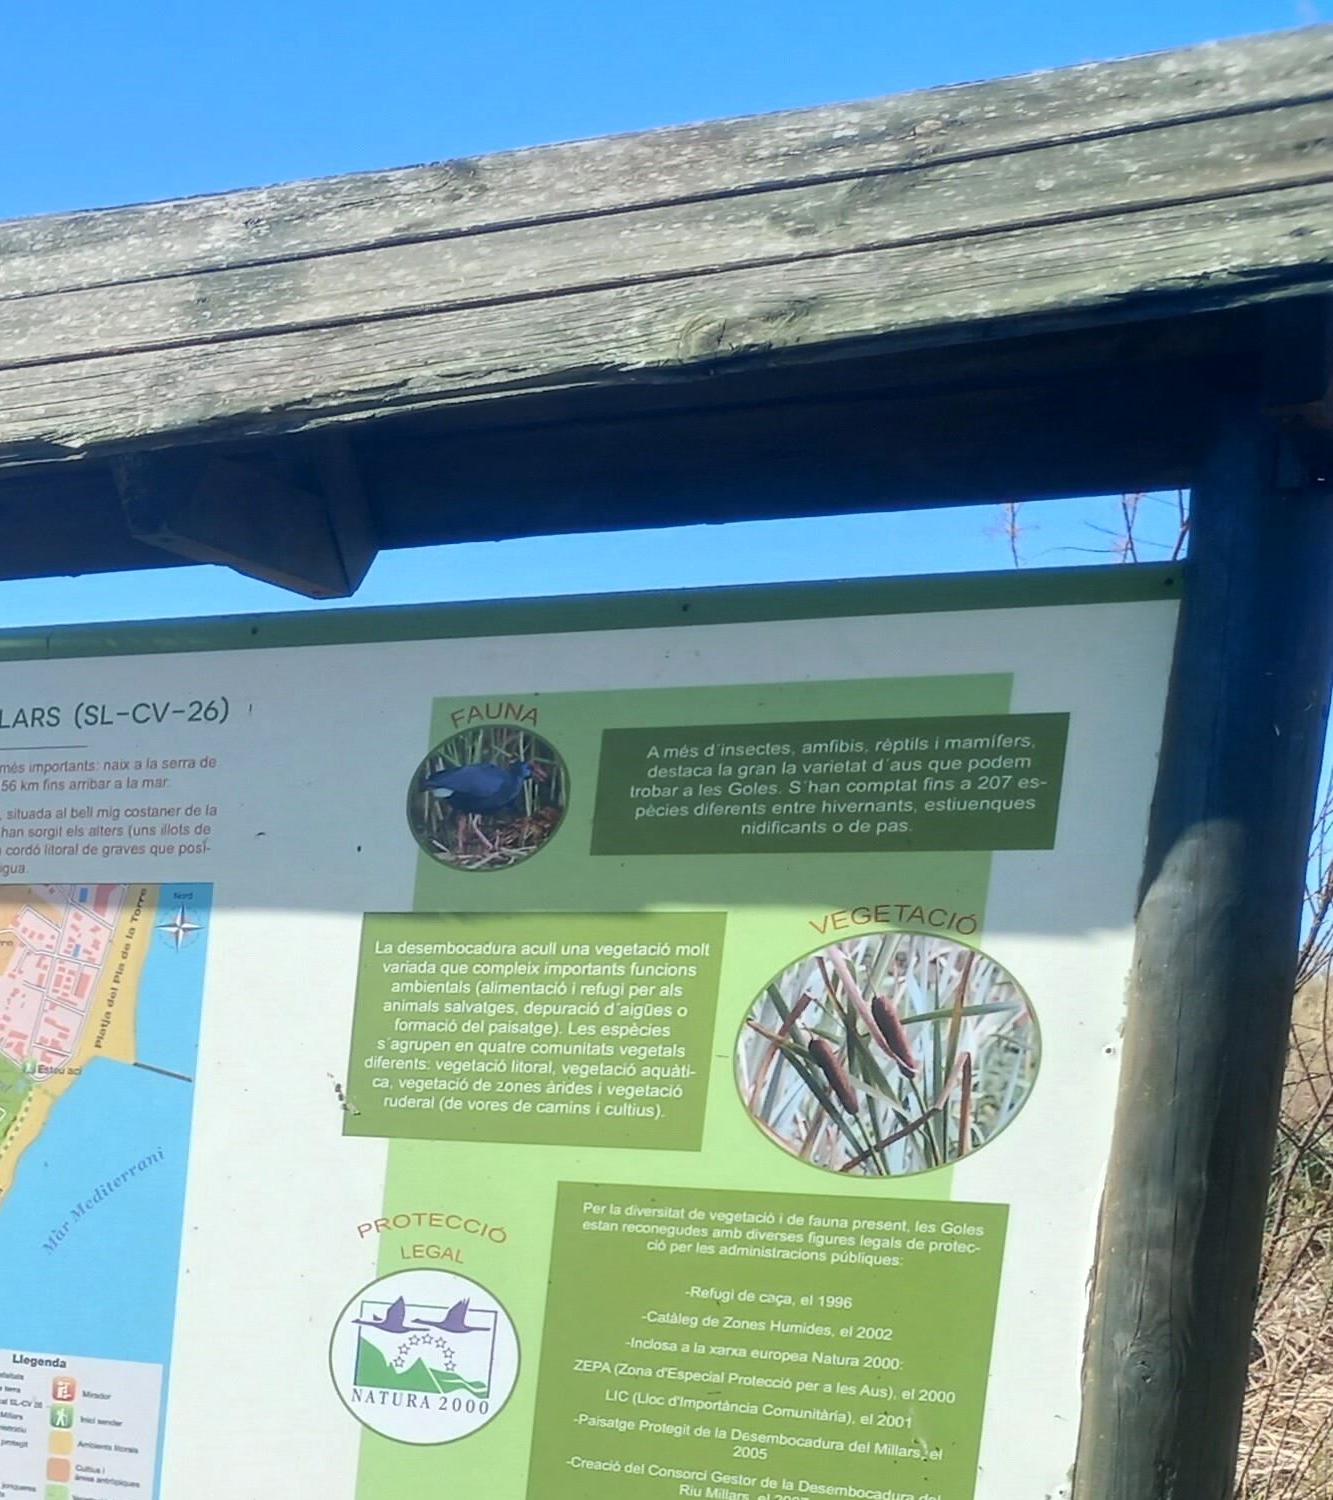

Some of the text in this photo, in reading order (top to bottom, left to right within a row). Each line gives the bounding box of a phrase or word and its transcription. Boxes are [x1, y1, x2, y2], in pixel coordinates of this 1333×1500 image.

[74, 696, 229, 730] (SL-CV-26)
[451, 702, 537, 729] FAUNA
[646, 745, 661, 759] A
[663, 744, 699, 759] més
[801, 738, 869, 755] amfibis,
[875, 736, 929, 755] rèptils
[934, 736, 939, 751] i
[944, 734, 1035, 750] mamífers,
[102, 760, 131, 776] naix
[144, 757, 158, 770] la
[161, 758, 197, 770] serra
[199, 755, 217, 769] de
[647, 764, 713, 779] destaca
[717, 762, 733, 777] la
[737, 764, 777, 779] gran
[781, 761, 797, 775] la
[802, 759, 867, 775] varietat
[927, 759, 963, 774] que
[967, 754, 1032, 773] podem
[629, 783, 679, 799] trobar
[682, 786, 693, 797] a
[698, 783, 723, 797] les
[727, 781, 782, 796] Goles.
[845, 778, 918, 796] comptat
[923, 776, 955, 792] fins
[959, 779, 973, 791] a
[977, 775, 1013, 790] 207
[1017, 777, 1048, 789] es-
[634, 796, 1036, 821] pècies diferents entre hivernants, estiuenques
[741, 819, 912, 836] nidificants o de pas.
[809, 904, 977, 935] VEGETACIÓ
[374, 940, 710, 959] La desembocadura acull una vegetació molt
[94, 888, 147, 1049] Platja del Pla de la Torre
[382, 959, 697, 979] variada que compleix importants funcions
[390, 979, 683, 1000] ambientals (alimentació i refugi per als
[383, 998, 440, 1013] animals
[443, 999, 519, 1017] salvatges,
[523, 1000, 601, 1019] depuració
[676, 1006, 689, 1018] o
[394, 1017, 671, 1040] formació del paisatge). Les espècies
[70, 1146, 165, 1223] Mediterrani
[357, 1213, 507, 1243] PROTECCIÓ
[400, 1244, 464, 1264] LEGAL
[684, 1285, 853, 1310] -Refugi de caça, el 1996
[641, 1310, 893, 1341] -Catàleg de Zones Humides, el 2002
[12, 1354, 67, 1368] Llegenda
[625, 1336, 904, 1371] -Inclosa a la xarxa europea Natura 2000:
[351, 1388, 489, 1415] NATURA 2000
